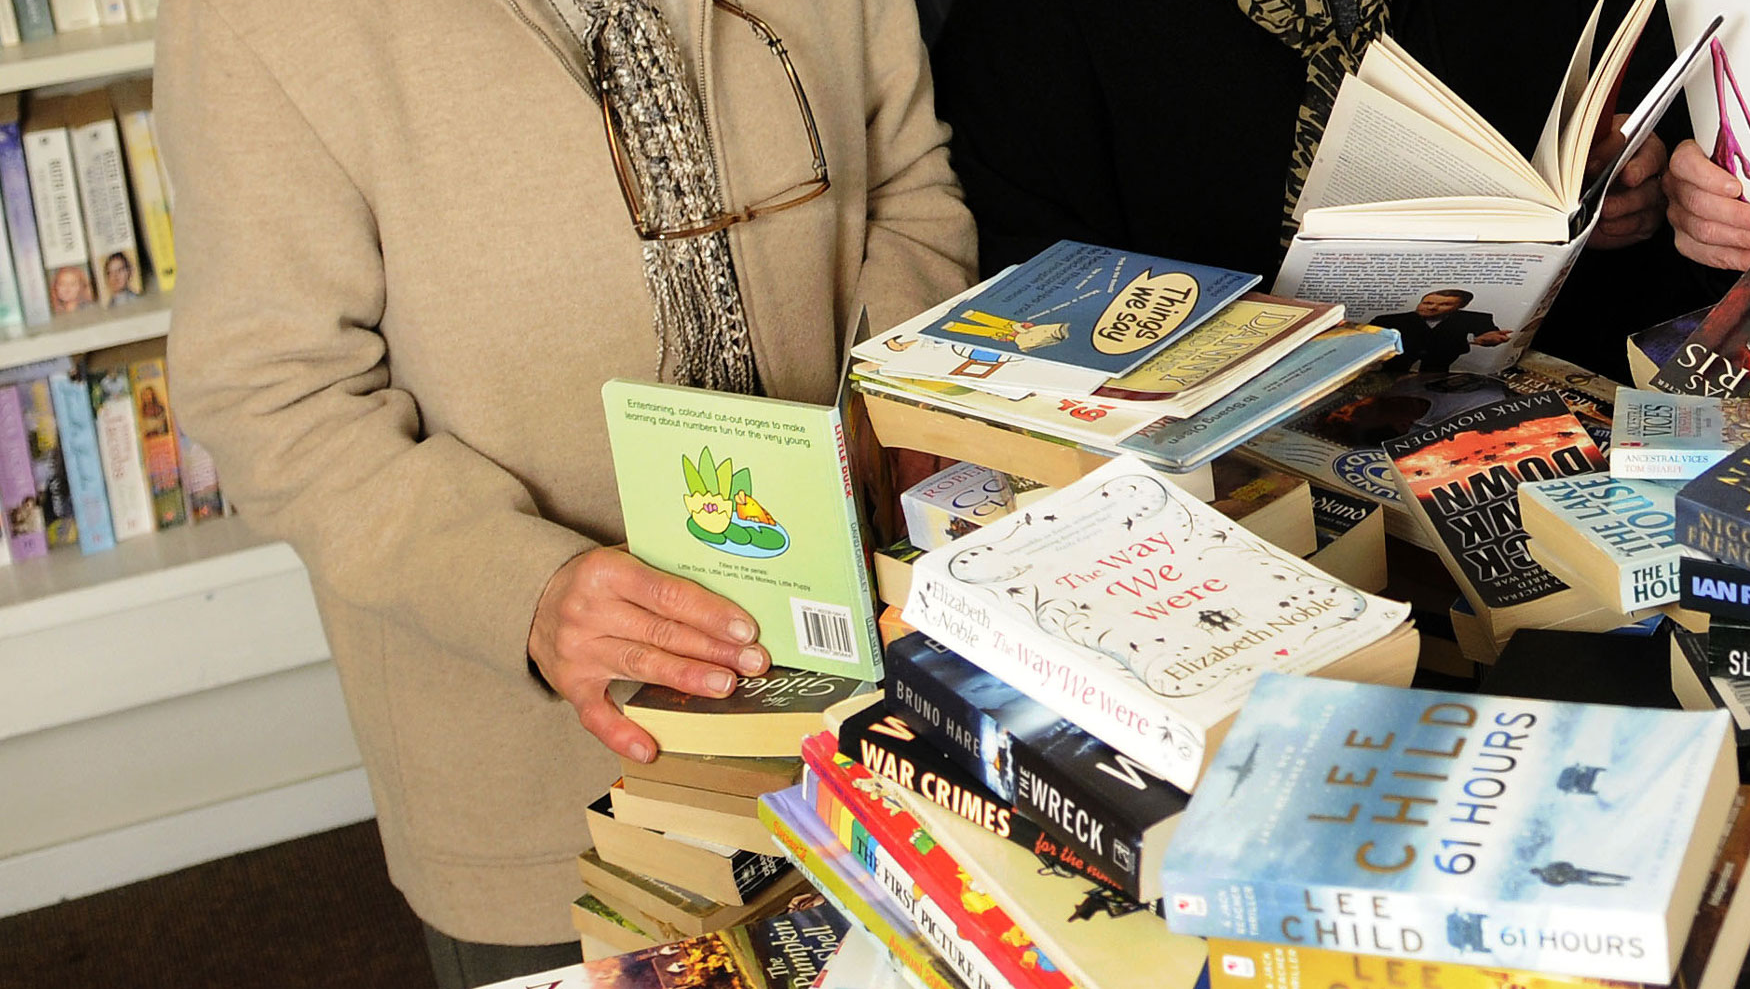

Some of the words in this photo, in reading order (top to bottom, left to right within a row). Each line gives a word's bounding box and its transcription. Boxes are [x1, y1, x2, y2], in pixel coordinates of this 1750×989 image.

[1135, 287, 1193, 340] Things
[1158, 310, 1297, 387] DANNY
[627, 399, 676, 416] Entertaining,
[678, 408, 712, 420] colourful
[715, 413, 742, 424] cut-out
[744, 417, 770, 429] pages
[772, 421, 781, 430] to
[782, 423, 805, 434] make
[1494, 393, 1553, 419] MARK
[1642, 403, 1673, 439] VICES
[624, 412, 657, 425] learning
[659, 417, 681, 427] about
[683, 420, 718, 434] numbers
[719, 426, 733, 435] fun
[735, 428, 745, 437] for
[748, 430, 761, 440] the
[763, 433, 782, 445] very
[784, 436, 811, 448] young
[1394, 412, 1486, 452] BOWDEN
[1624, 455, 1680, 464] ANCESTRAL
[1681, 454, 1709, 464] VICES
[1430, 445, 1594, 516] DOWN
[1054, 562, 1104, 593] The
[1095, 526, 1178, 571] Way
[1633, 567, 1664, 585] THE
[1104, 560, 1184, 602] We
[1130, 573, 1230, 624] were
[1692, 575, 1738, 603] IAN
[930, 578, 992, 632] Elizabeth
[935, 612, 981, 651] Noble
[1162, 626, 1275, 685] Elizabeth
[1265, 591, 1342, 641] Noble
[992, 629, 1017, 660] The
[1015, 645, 1057, 691] Way
[1055, 665, 1097, 706] We
[1097, 692, 1151, 738] were
[895, 678, 942, 730] BRUNO
[944, 715, 982, 761] HARE
[1018, 763, 1033, 801] THE
[1031, 774, 1105, 856] WRECK
[1307, 727, 1398, 827] LEE
[1448, 709, 1538, 828] HOURS
[858, 736, 917, 797] WAR
[919, 769, 1014, 841] CRIMES
[1353, 702, 1480, 875] CHILD
[1432, 836, 1484, 878] 61
[855, 835, 881, 878] THE
[884, 866, 917, 916] FIRST
[920, 910, 976, 985] PICTURE
[1303, 890, 1394, 920] LEE
[769, 920, 818, 988] Pumpkin
[802, 925, 839, 961] Shell
[1279, 915, 1426, 955] CHILD
[1499, 926, 1528, 950] 61
[1539, 928, 1646, 961] HOURS
[767, 956, 790, 979] The
